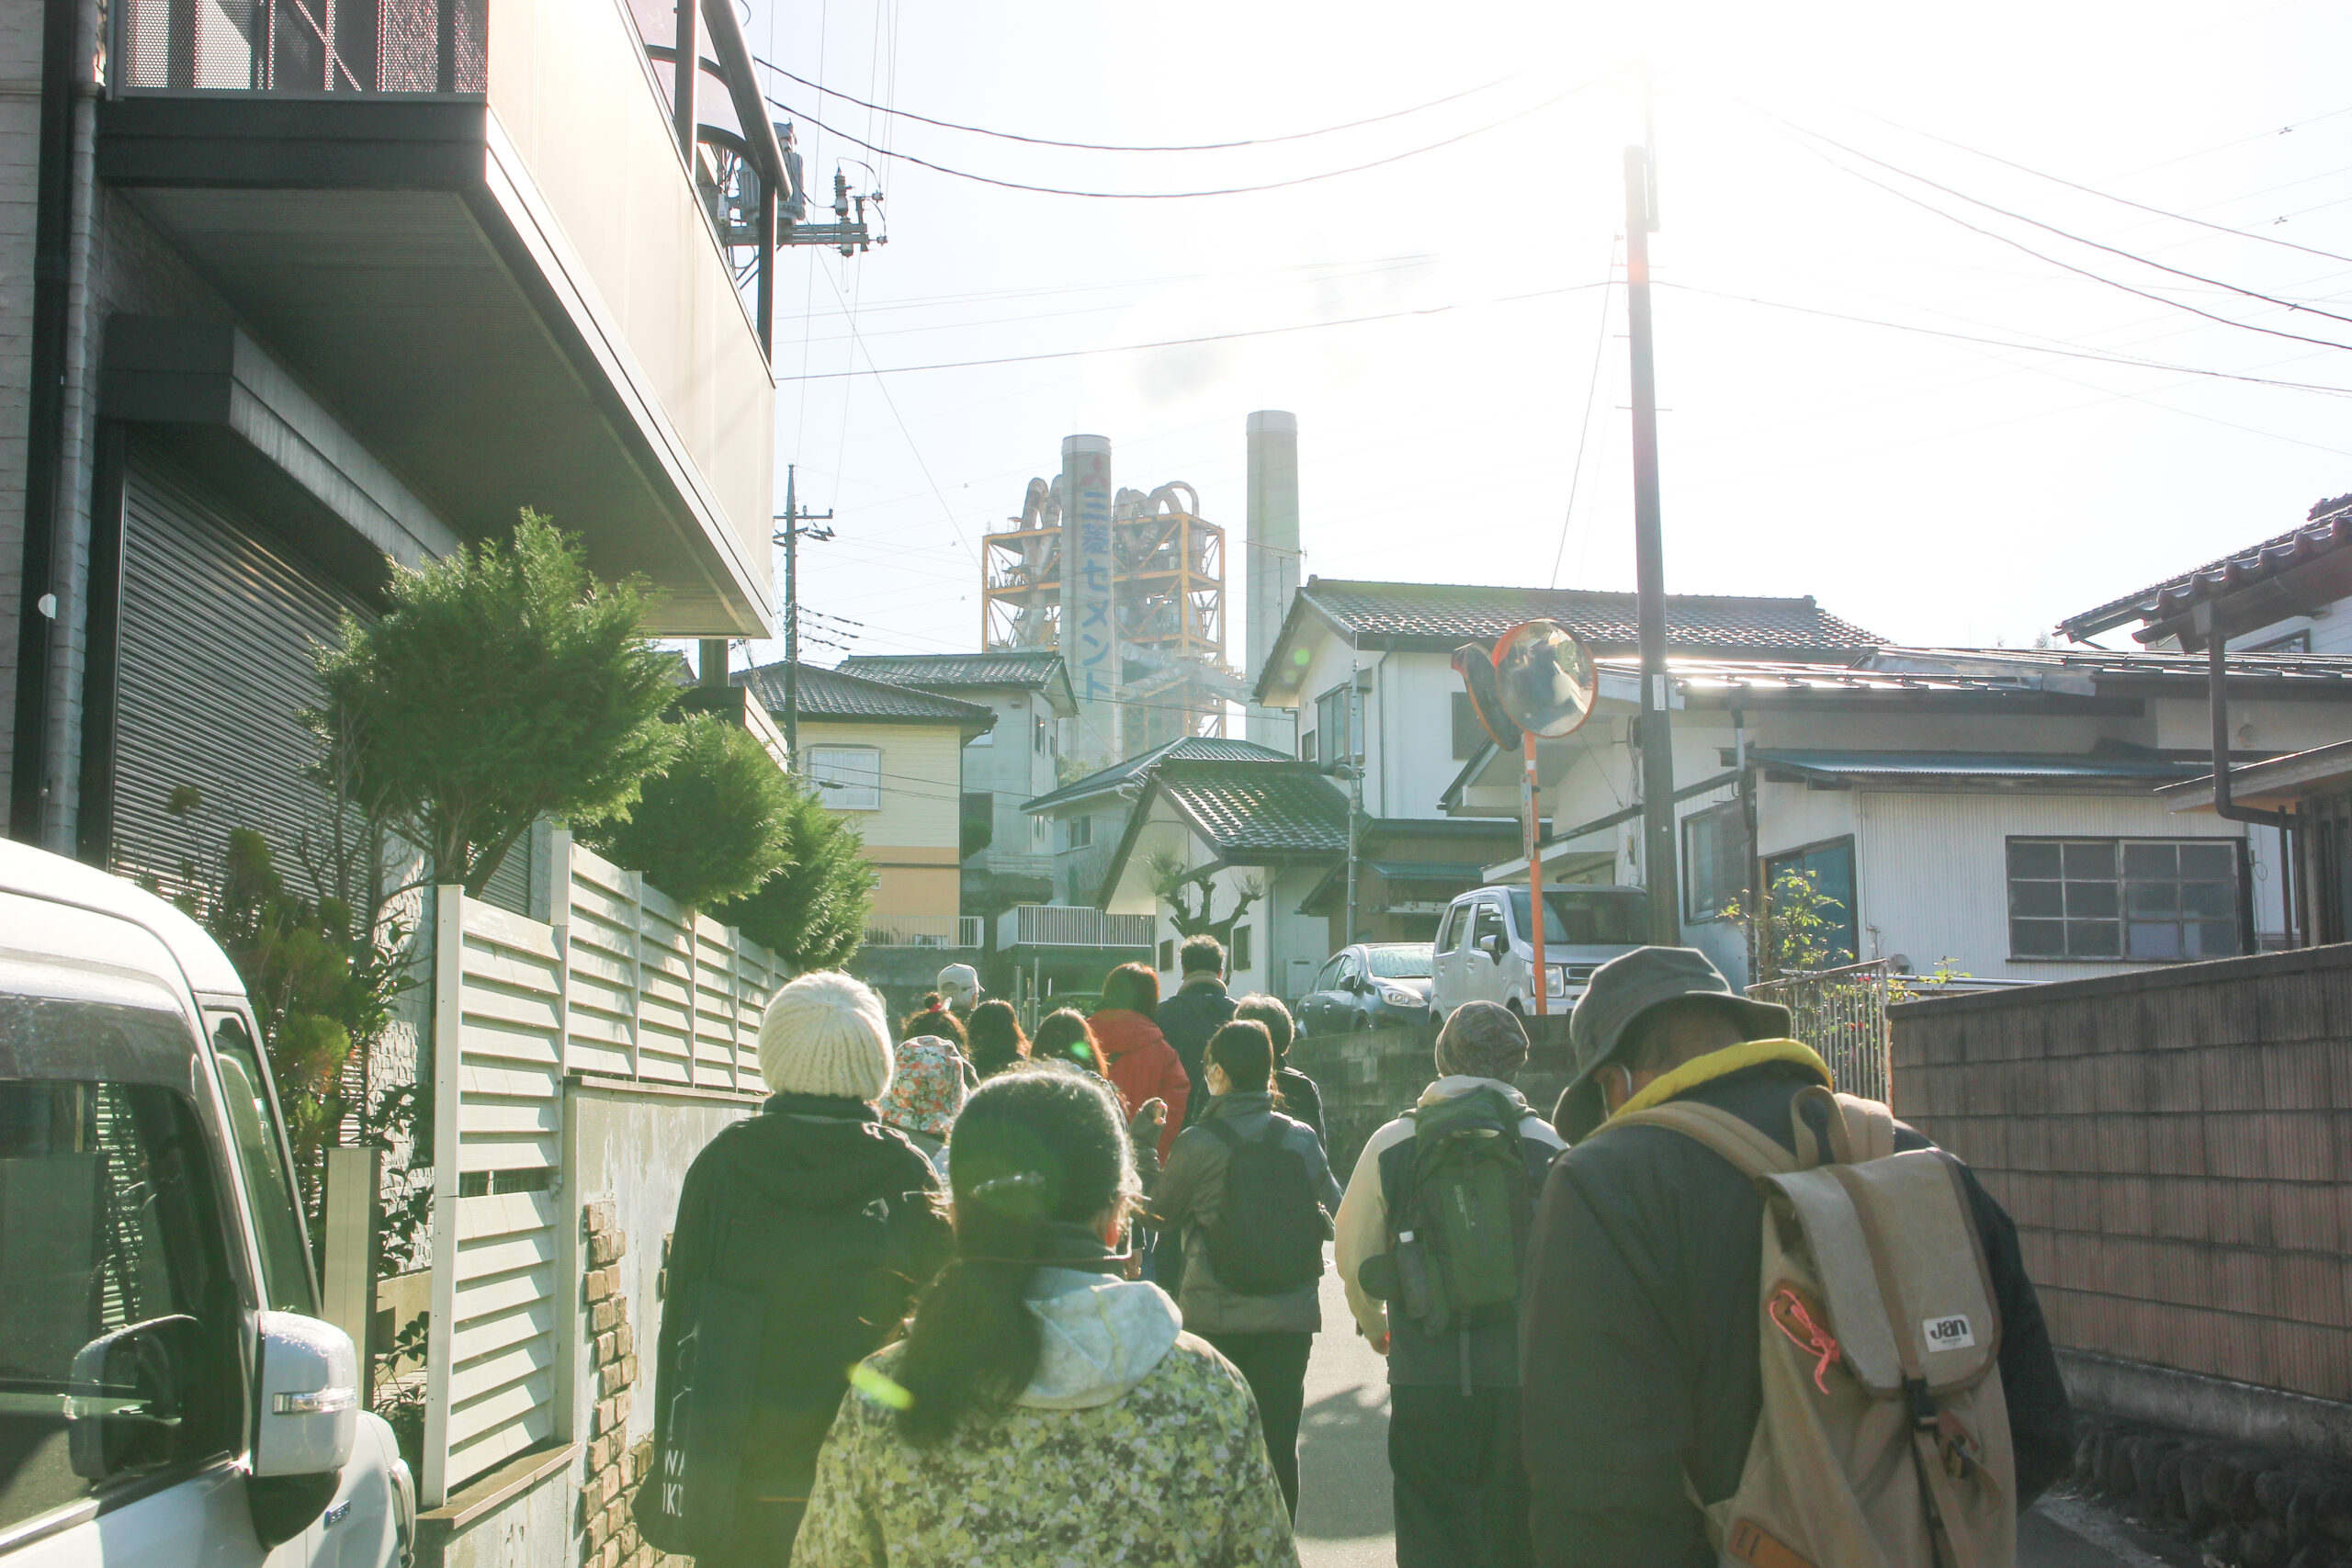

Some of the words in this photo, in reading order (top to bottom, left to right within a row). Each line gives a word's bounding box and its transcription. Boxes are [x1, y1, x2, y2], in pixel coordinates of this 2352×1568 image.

[1081, 491, 1111, 705] 三菱セメント
